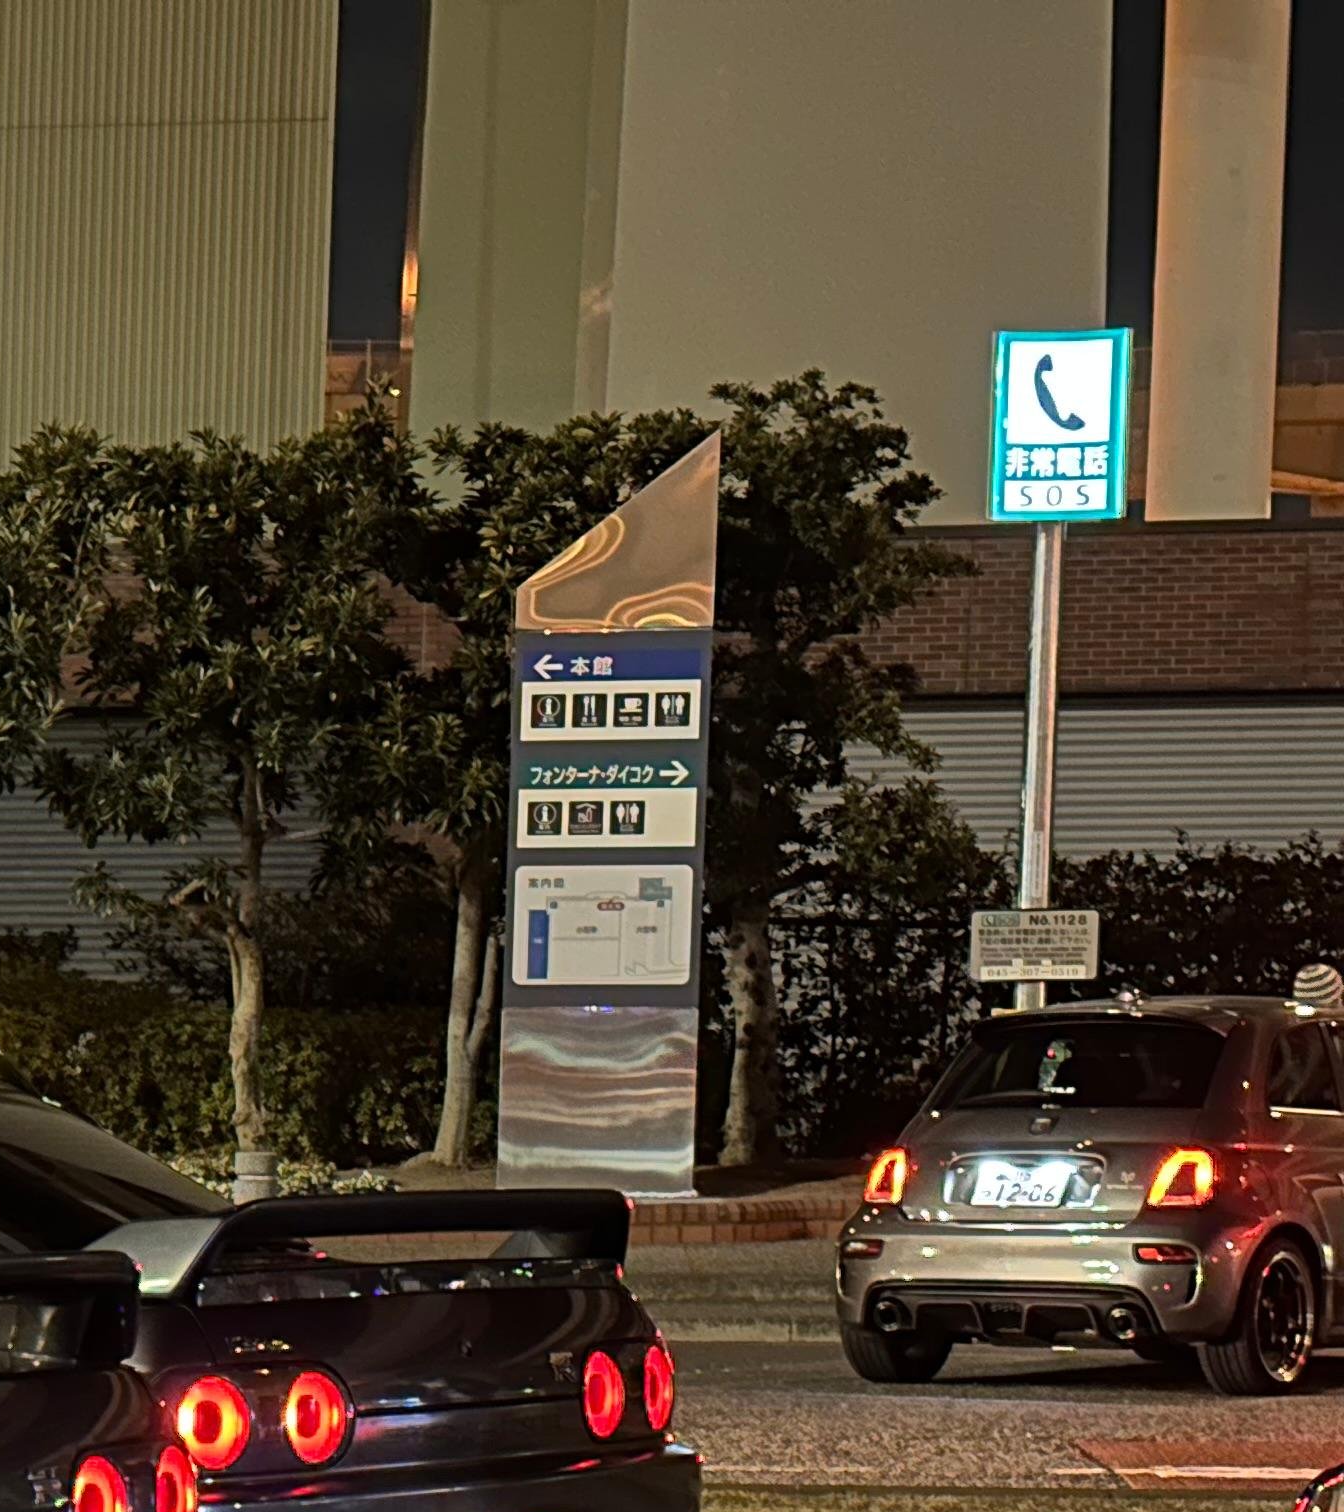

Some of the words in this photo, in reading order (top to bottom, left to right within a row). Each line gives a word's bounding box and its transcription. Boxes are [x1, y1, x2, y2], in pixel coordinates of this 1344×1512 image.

[1005, 445, 1109, 478] 非常電話
[1019, 484, 1091, 507] SOS
[570, 656, 614, 676] 本館
